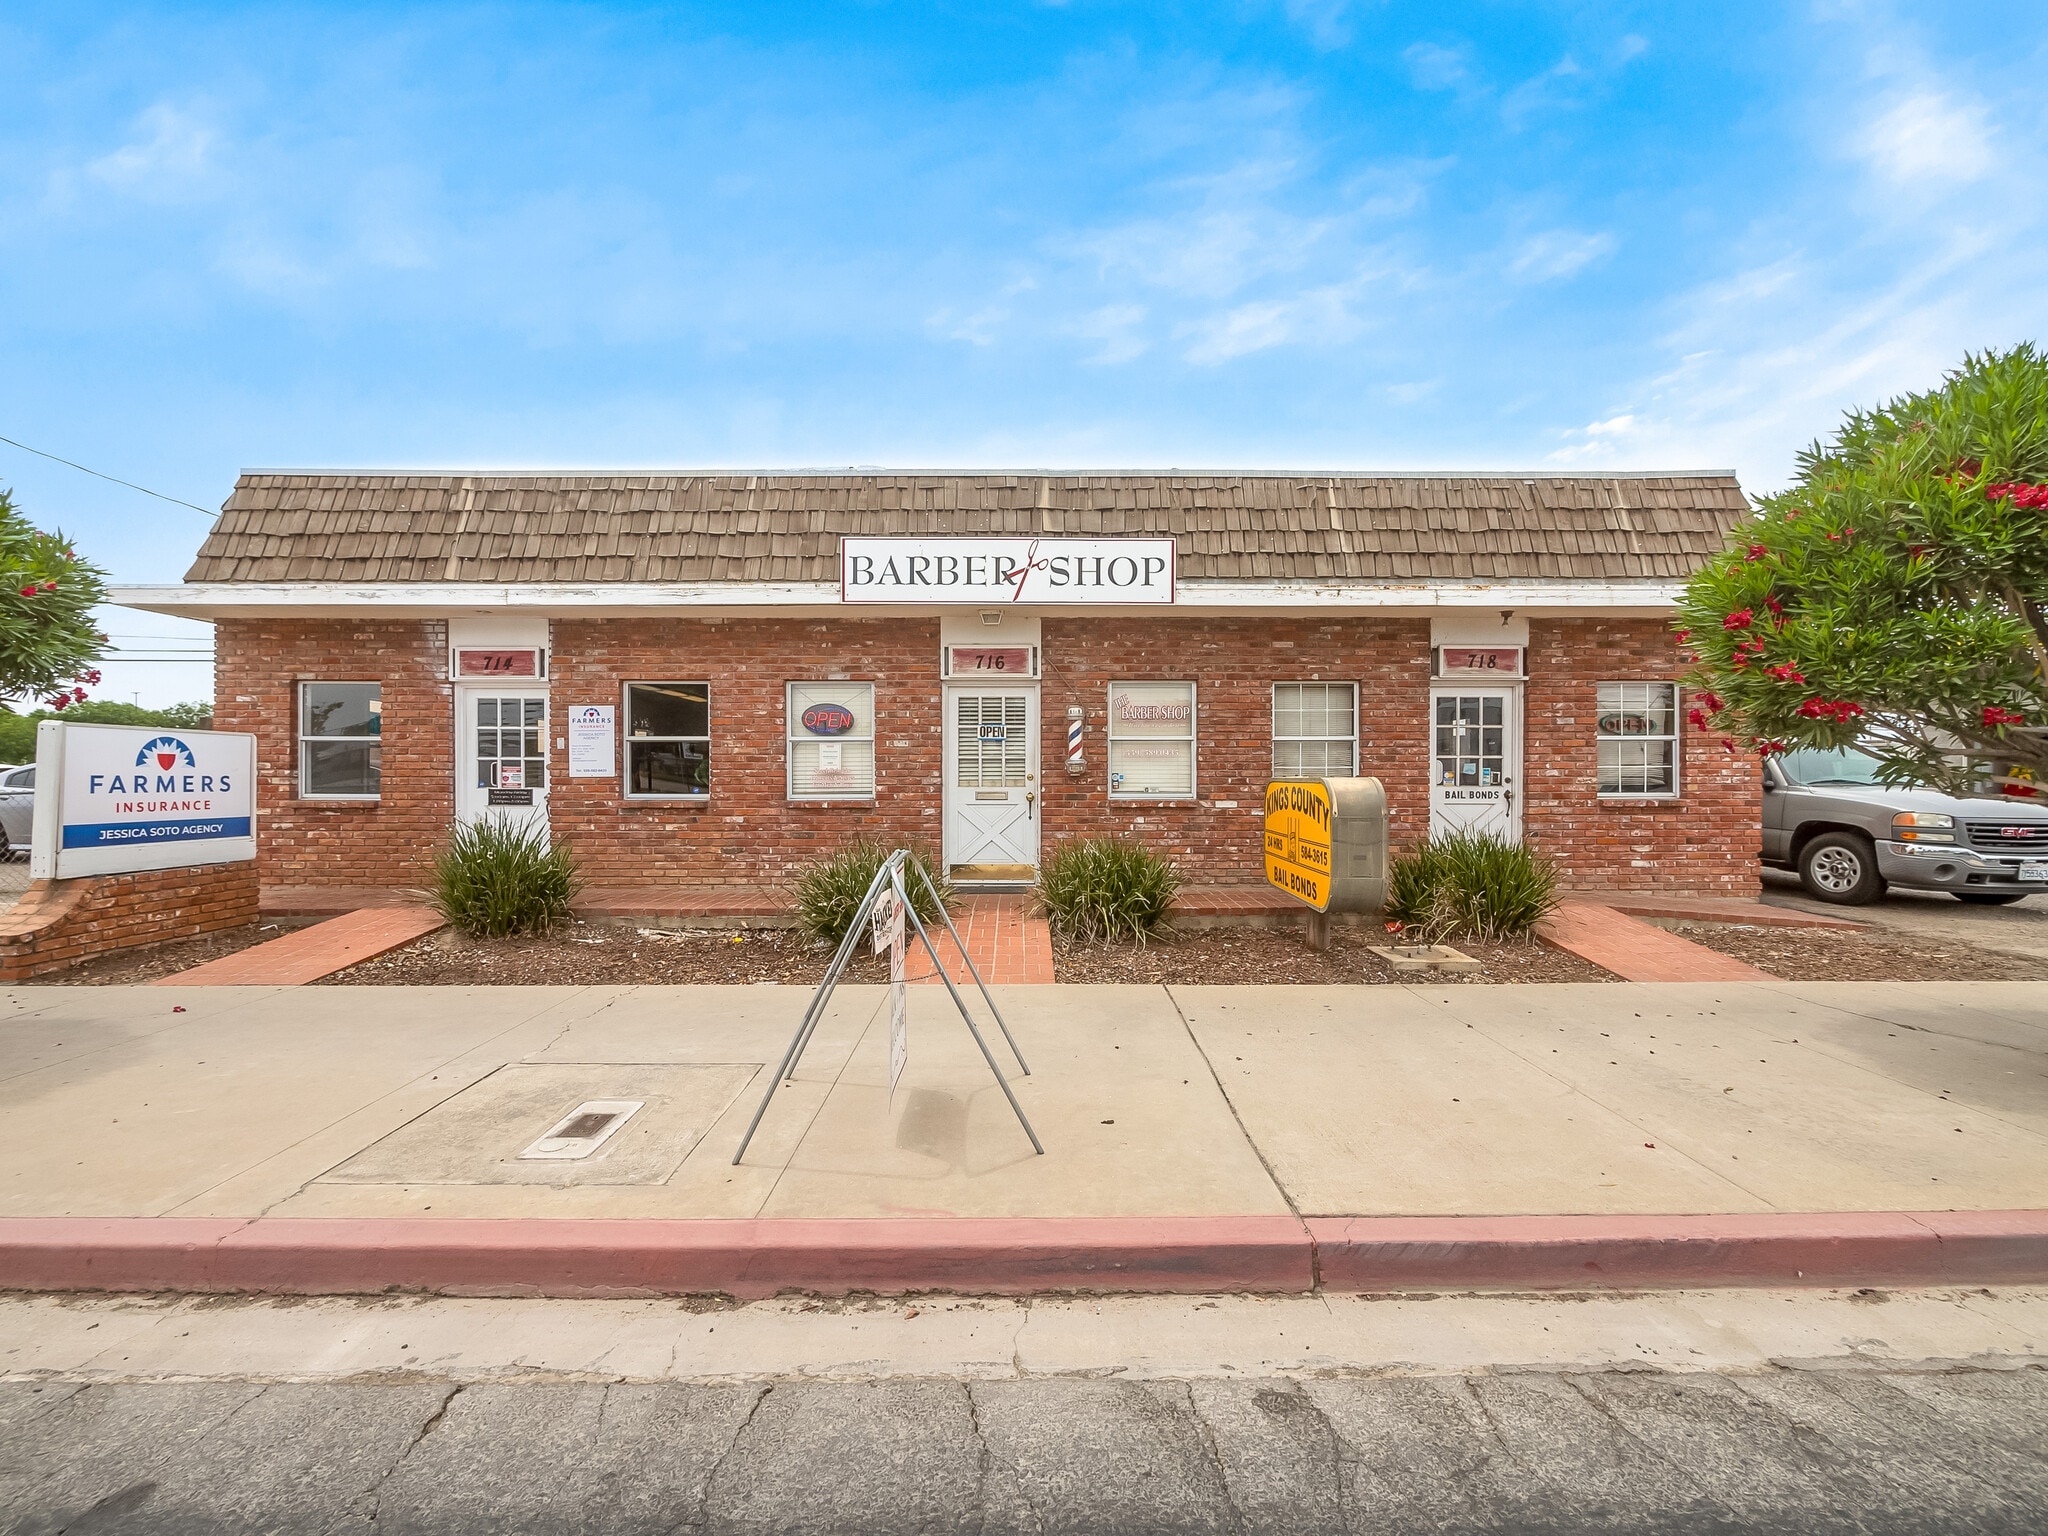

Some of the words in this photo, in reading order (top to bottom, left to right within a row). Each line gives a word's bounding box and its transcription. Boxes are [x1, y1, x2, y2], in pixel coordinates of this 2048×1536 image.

[849, 555, 1018, 587] BARBER
[1049, 555, 1166, 587] SHOP
[484, 656, 513, 670] 714
[975, 655, 1005, 670] 716
[1468, 654, 1497, 668] 718
[1114, 694, 1130, 709] THE
[804, 711, 851, 728] OPEN
[1121, 706, 1159, 720] BARBER
[1160, 706, 1190, 720] SHOP
[980, 726, 1005, 737] OPEN
[90, 775, 231, 794] FARMERS
[1445, 790, 1466, 799] BAIL
[1469, 790, 1499, 799] BONDS
[116, 800, 211, 813] INSURANCE
[1267, 786, 1289, 819] KINGS
[1291, 786, 1329, 832] COUNTY
[99, 828, 148, 840] JESSICA
[150, 826, 179, 837] SOTO
[181, 824, 223, 835] AGENCY
[2001, 827, 2036, 838] GMC
[1267, 835, 1273, 848] 24
[1273, 839, 1283, 851] HRS
[1301, 846, 1328, 866] 584-3615
[1273, 866, 1289, 887] BAIL
[1290, 872, 1317, 900] BONDS
